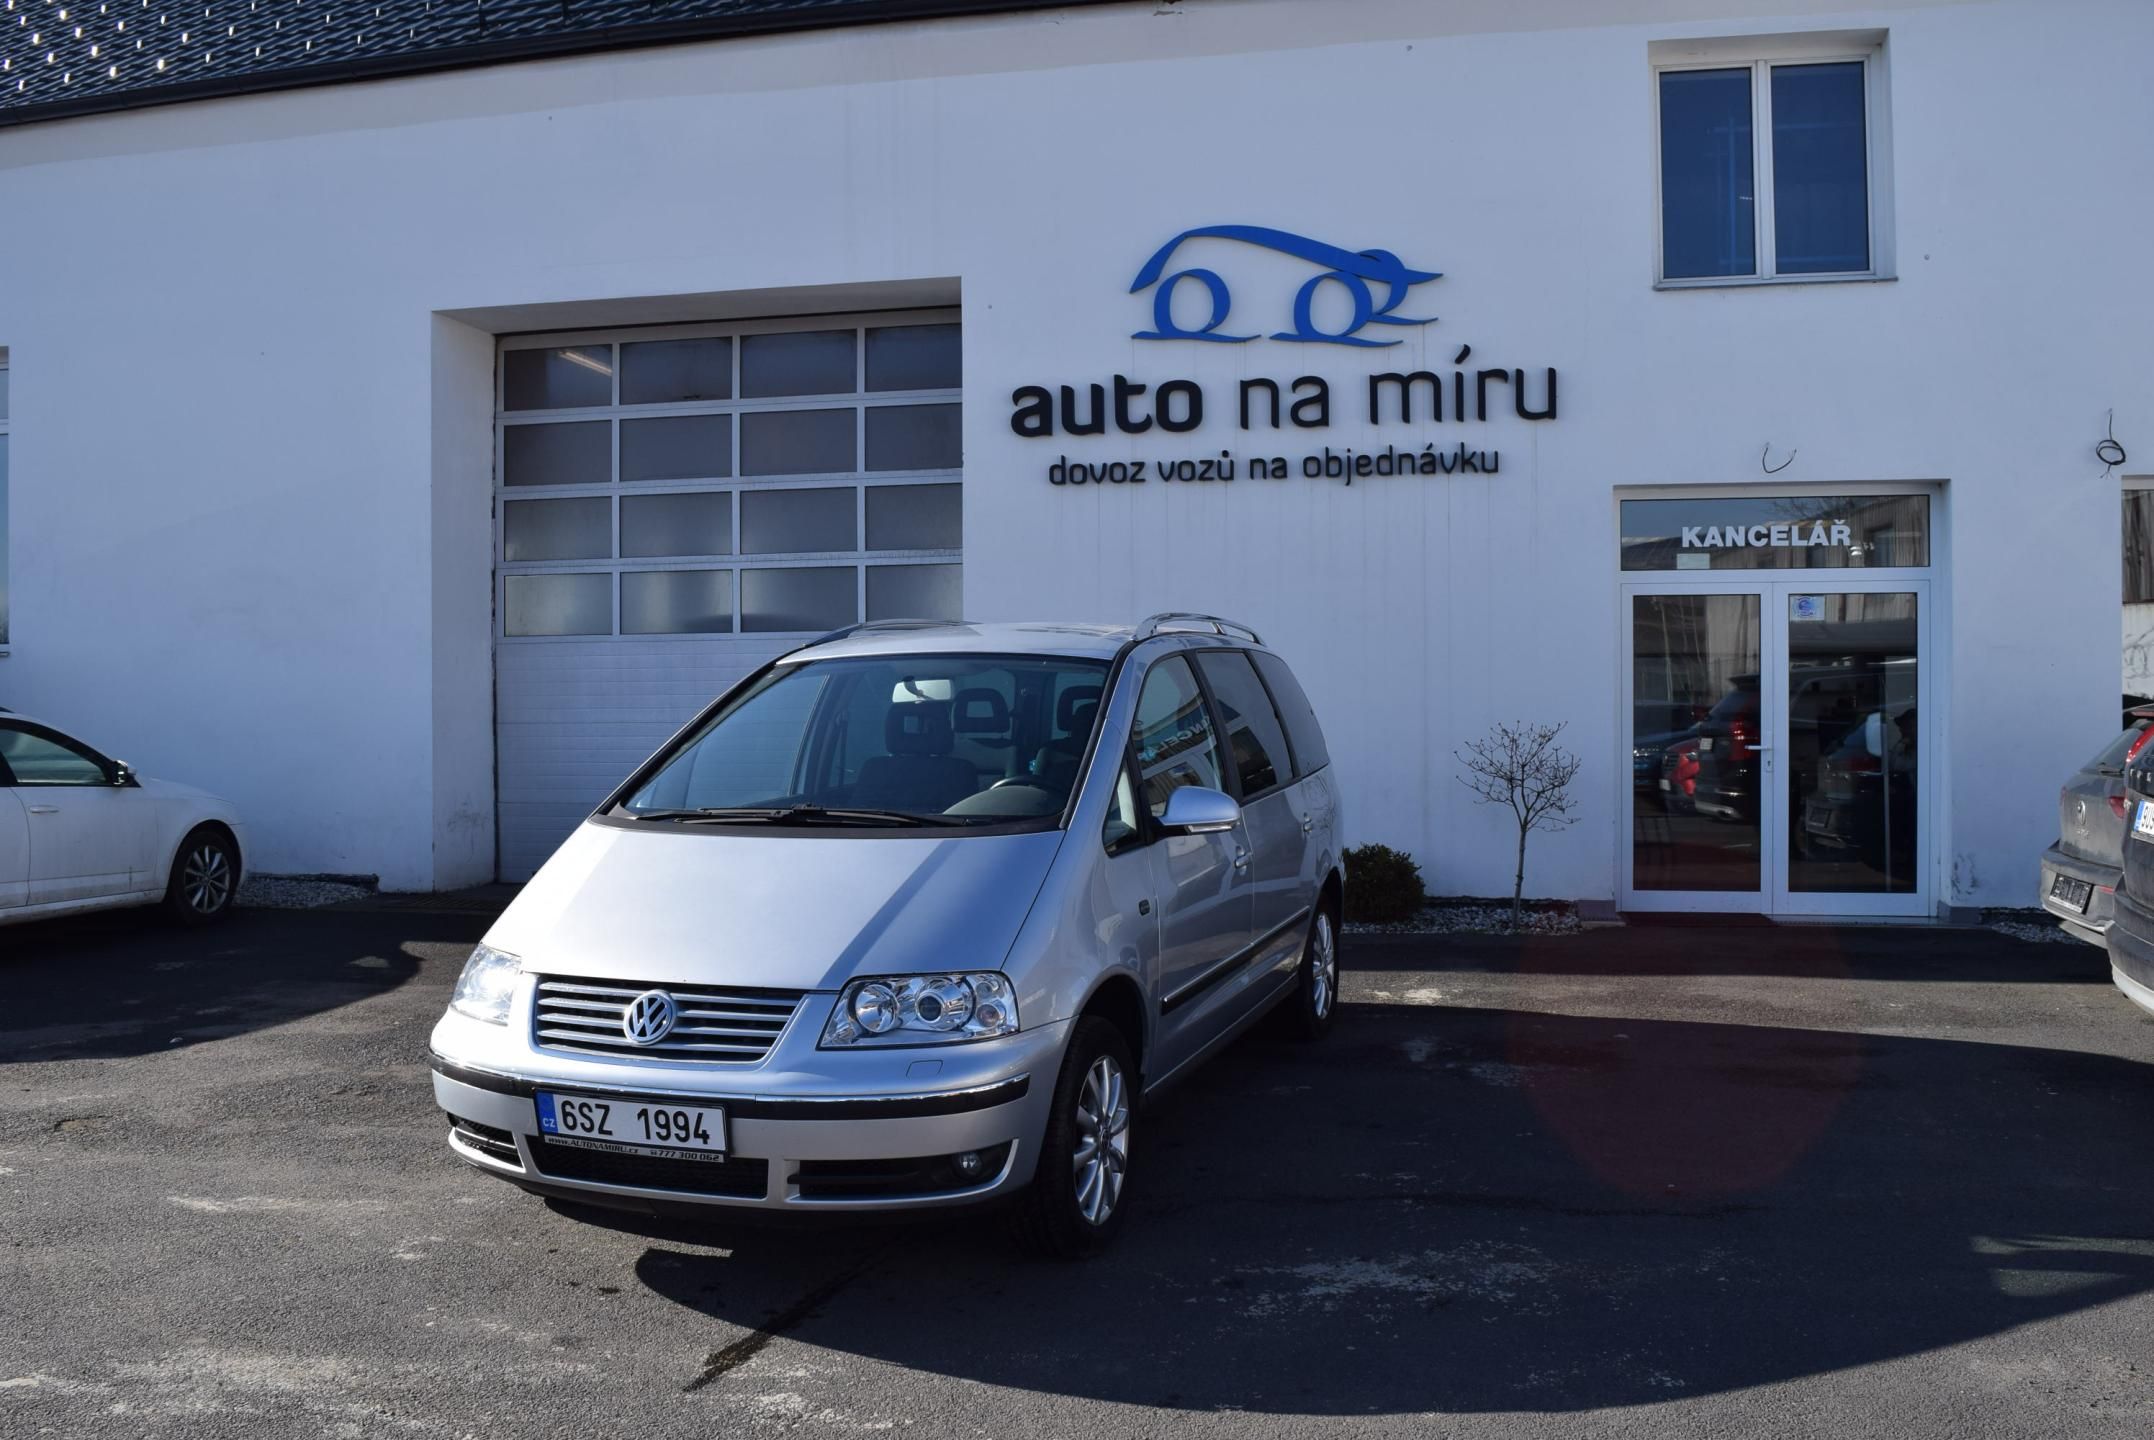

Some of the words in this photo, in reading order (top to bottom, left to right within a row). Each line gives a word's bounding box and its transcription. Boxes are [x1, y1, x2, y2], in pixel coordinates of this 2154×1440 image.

[1010, 374, 1203, 437] auto
[1239, 374, 1329, 430] na
[1369, 344, 1557, 426] míru
[1048, 455, 1146, 486] dovoz
[1157, 449, 1235, 483] vozů
[1249, 453, 1288, 480] na
[1302, 441, 1500, 486] objednávku
[1681, 519, 1851, 547] KANCELÁŘ
[542, 1117, 556, 1128] CZ
[561, 1100, 613, 1136] 6SZ
[637, 1108, 710, 1145] 1994
